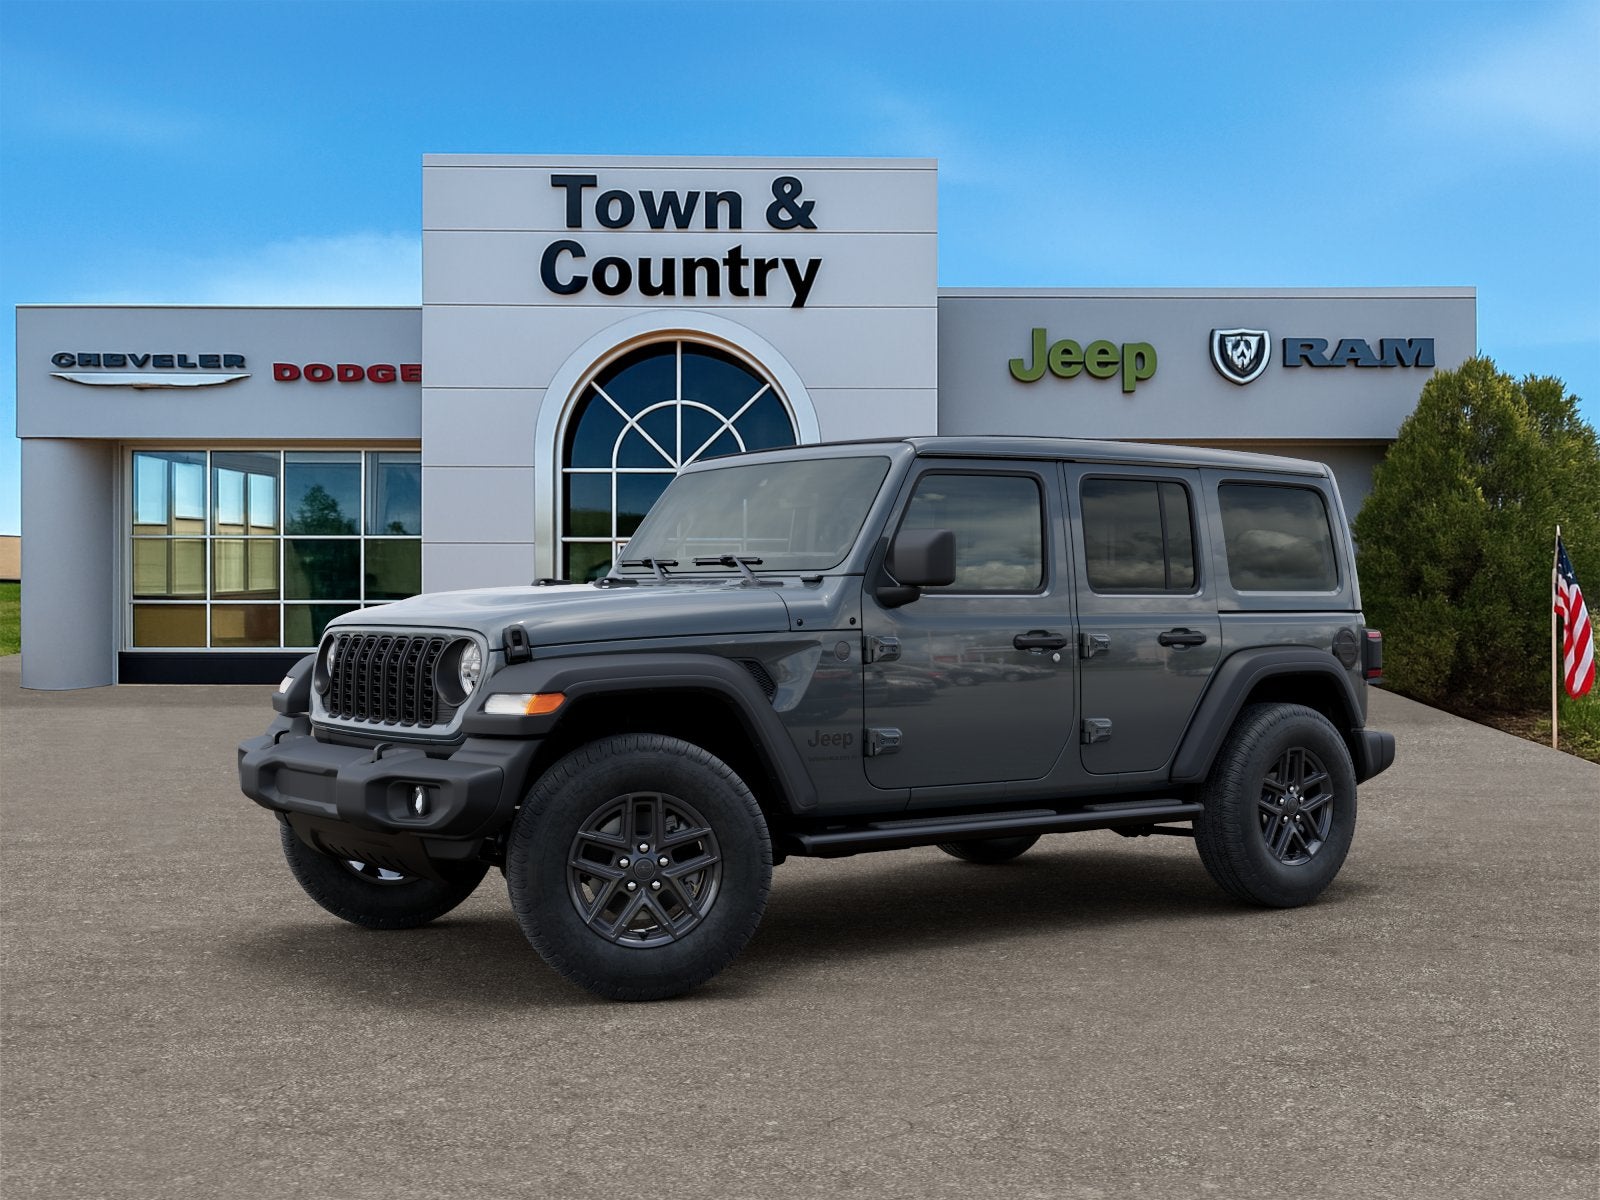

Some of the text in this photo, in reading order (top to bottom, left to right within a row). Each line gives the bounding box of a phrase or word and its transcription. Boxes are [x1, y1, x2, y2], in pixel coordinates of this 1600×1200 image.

[550, 173, 818, 230] Town &
[540, 239, 823, 308] Country
[273, 362, 422, 383] DODGE
[1009, 328, 1157, 393] Jeep
[1283, 337, 1435, 368] RAM
[807, 729, 853, 749] Jeep
